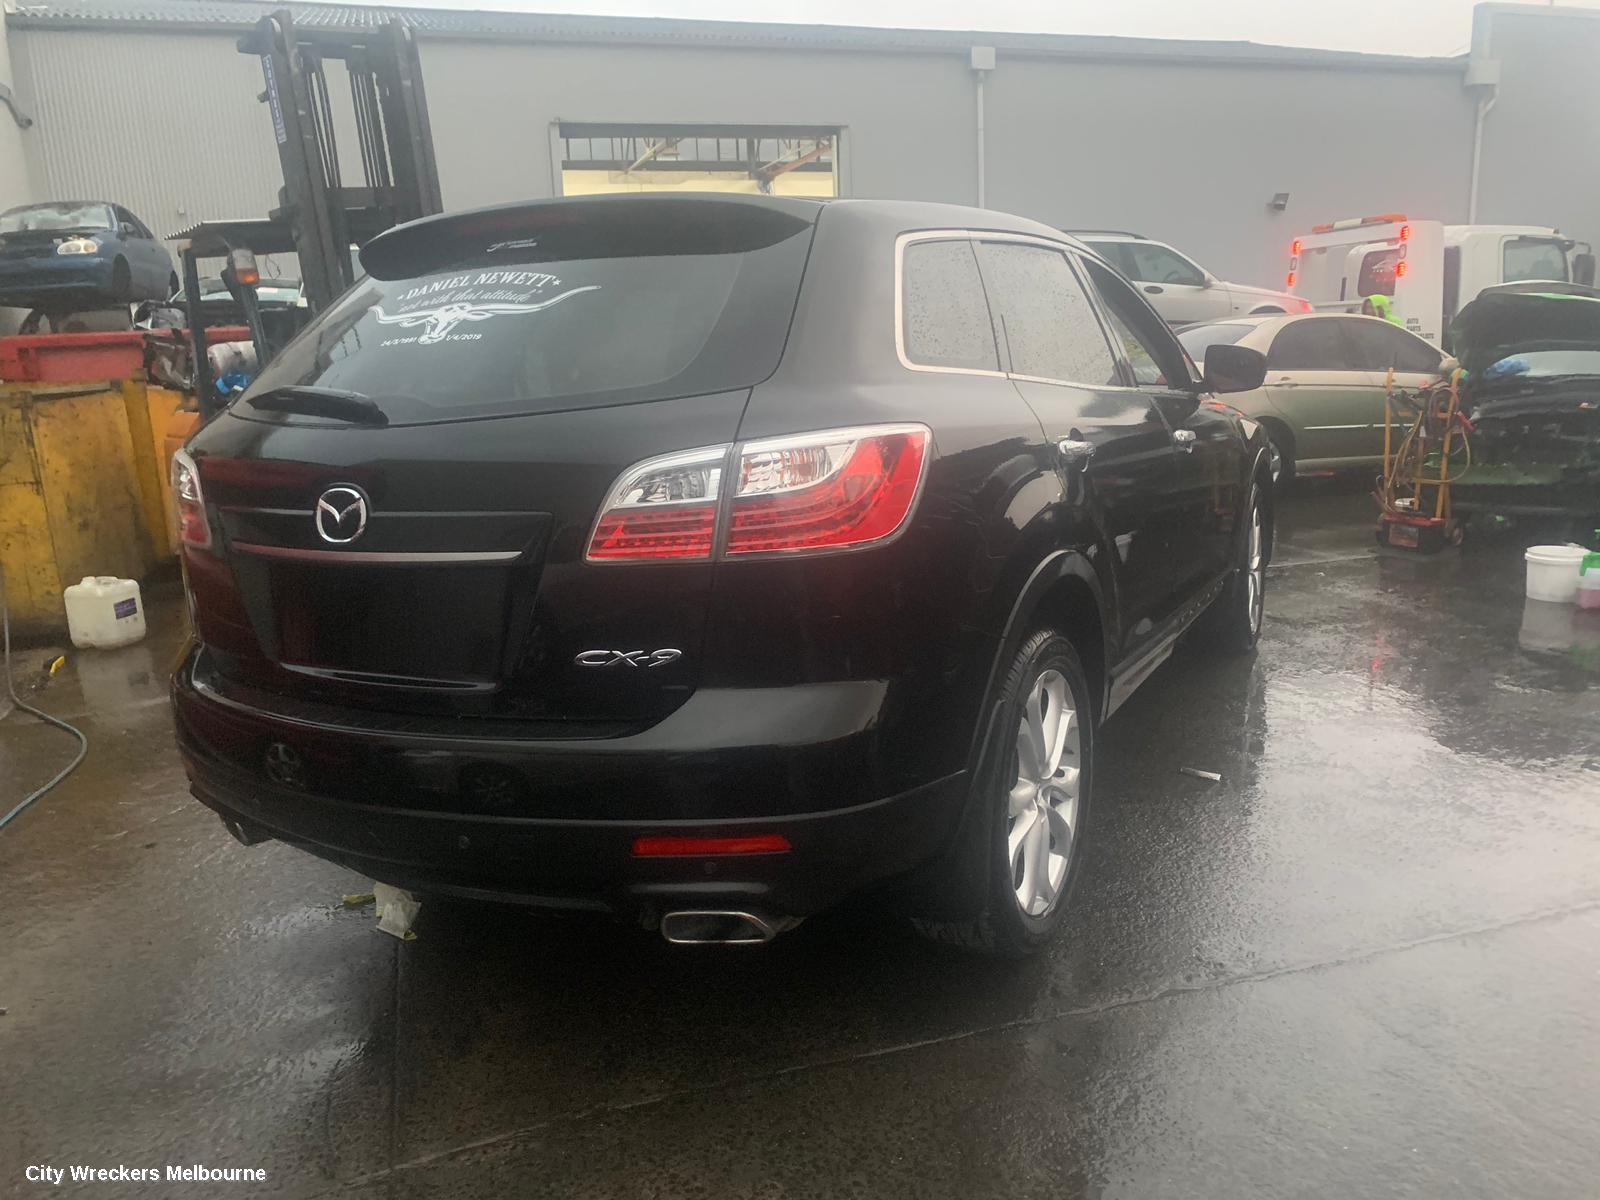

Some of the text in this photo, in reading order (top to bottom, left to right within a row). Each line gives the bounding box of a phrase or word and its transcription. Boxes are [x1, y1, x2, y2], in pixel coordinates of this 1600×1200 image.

[406, 271, 556, 300] DANIEL NEWETT
[574, 648, 682, 667] CX-9
